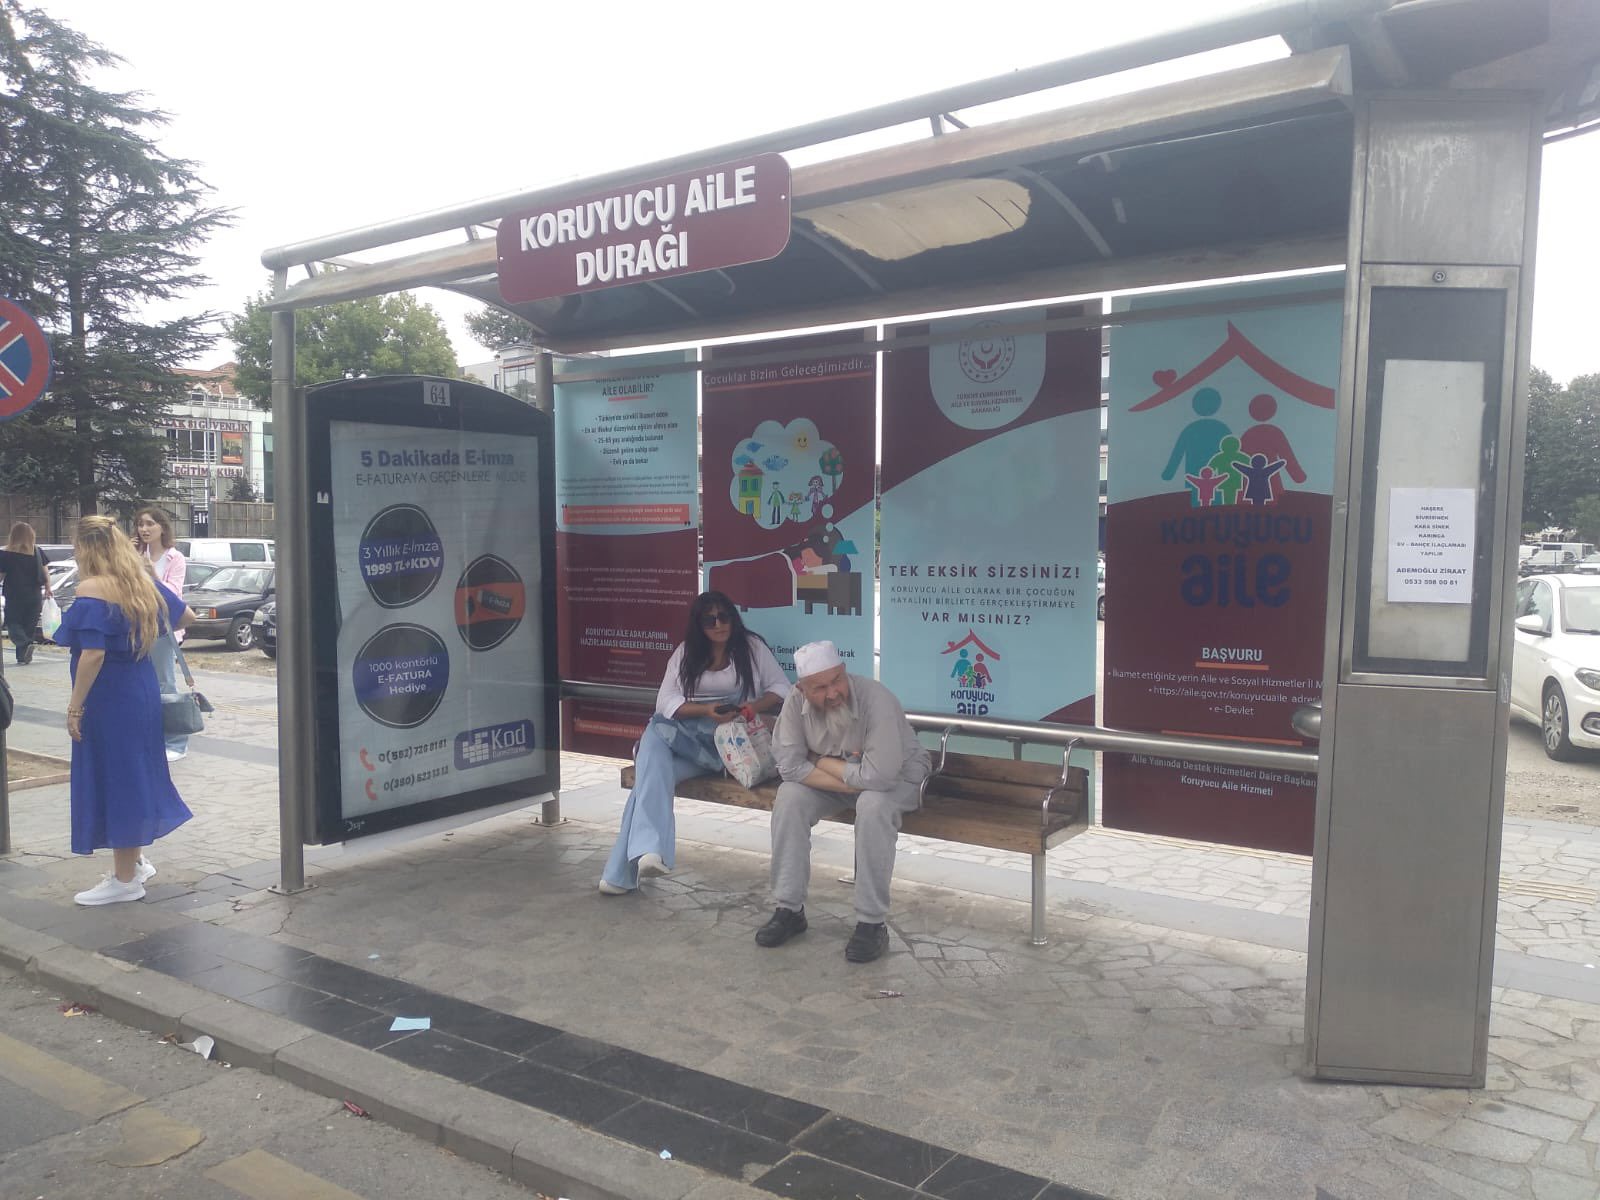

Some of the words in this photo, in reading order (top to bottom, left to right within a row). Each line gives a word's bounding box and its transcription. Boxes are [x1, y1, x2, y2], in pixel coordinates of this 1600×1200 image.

[520, 184, 676, 251] KORUYUCU
[684, 166, 757, 217] AİLE
[576, 223, 688, 286] DURAĞI
[704, 371, 747, 386] Çocuklar
[750, 368, 778, 380] Bizim
[430, 385, 446, 405] 64
[360, 450, 373, 468] 5
[378, 449, 461, 467] Dakikada
[355, 471, 427, 487] E-FATURAYA
[430, 470, 491, 486] GEÇENLERE
[362, 546, 371, 559] 3
[374, 543, 401, 558] Yıllık
[365, 562, 393, 577] 1999
[889, 565, 919, 577] TEK
[927, 563, 978, 578] EKSİK
[988, 563, 1080, 579] SİZSİNİZ!
[1440, 567, 1467, 575] ZİRAAT
[1181, 552, 1291, 609] aile
[890, 586, 937, 594] KORUYUCU
[941, 585, 961, 594] AİLE
[965, 587, 1000, 595] OLARAK
[1006, 586, 1021, 595] BİR
[1025, 587, 1075, 597] ÇOCUĞUN
[979, 598, 1076, 609] GERÇEKLEŞTİRMEYE
[921, 611, 950, 623] VAR
[958, 612, 1031, 625] MISINIZ?
[1202, 647, 1263, 662] BAŞVURU
[369, 662, 393, 673] 1000
[377, 669, 432, 684] E-FATURA
[1141, 669, 1176, 682] ettiğiniz
[1177, 672, 1199, 684] yerin
[1201, 672, 1218, 684] Aile
[1220, 676, 1230, 684] ve
[1231, 674, 1260, 688] Sosyal
[1261, 676, 1306, 688] Hizmetler
[389, 682, 427, 695] Hediye
[1225, 704, 1254, 716] Devlet
[491, 723, 526, 750] Kod
[1131, 754, 1147, 765] Aile
[1149, 756, 1181, 769] Yanında
[1183, 760, 1211, 773] Destek
[1213, 764, 1257, 778] Hizmetleri
[1259, 770, 1281, 783] Daire
[1181, 775, 1220, 790] Koruyucu
[1222, 779, 1239, 792] Aile
[1241, 783, 1274, 797] Hizmeti
